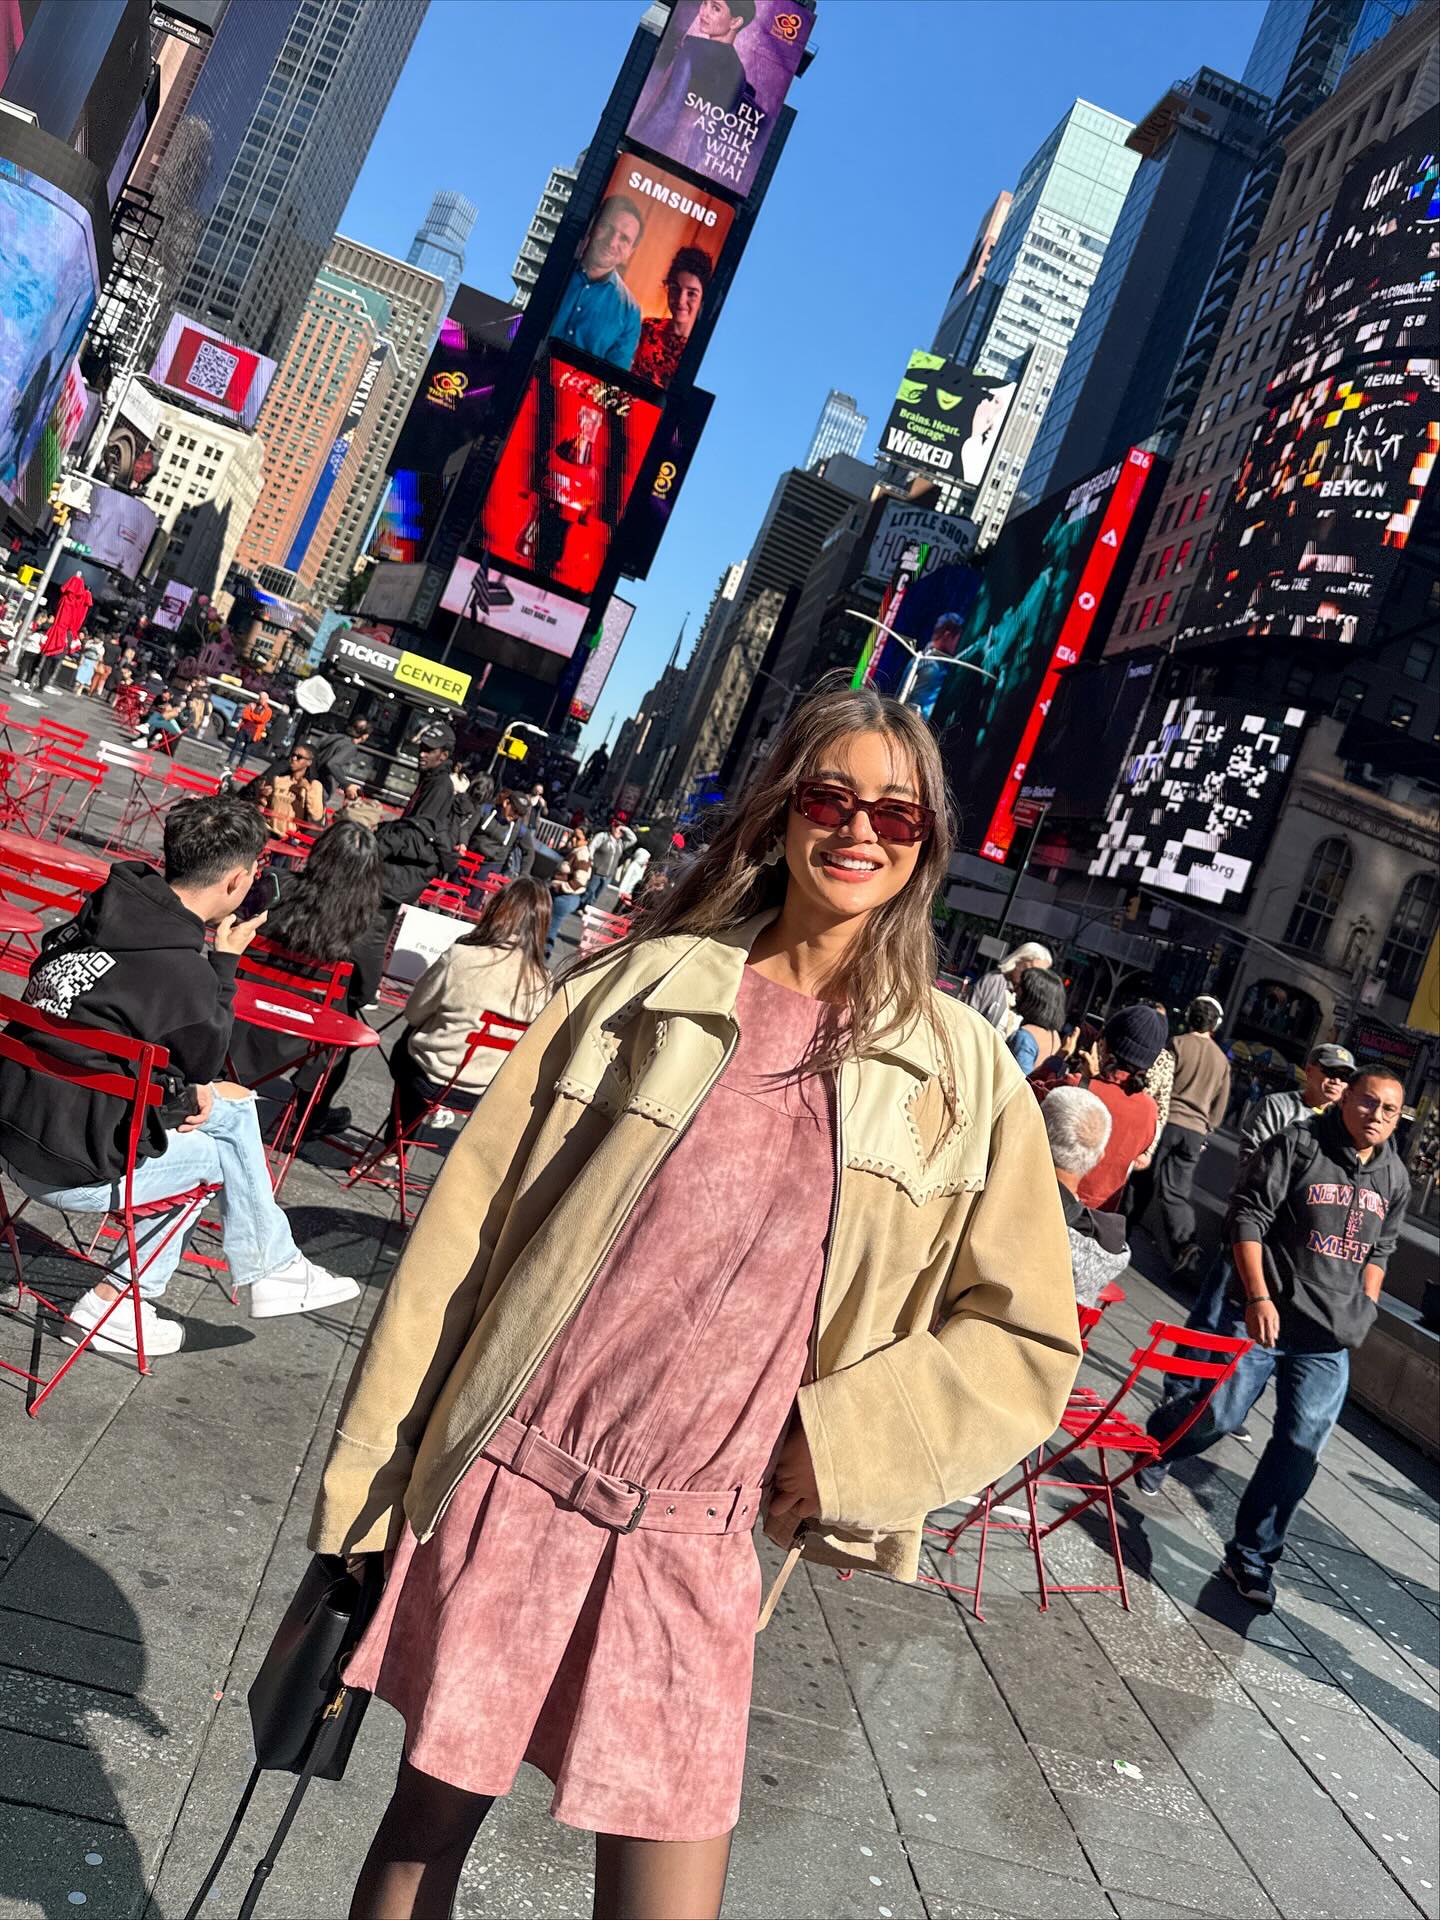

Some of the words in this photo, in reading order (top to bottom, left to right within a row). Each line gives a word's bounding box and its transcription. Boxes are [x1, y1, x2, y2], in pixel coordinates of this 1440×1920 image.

[684, 92, 759, 140] SMOOTH
[738, 103, 765, 125] FLY
[693, 115, 717, 134] AS
[718, 127, 752, 154] SILK
[704, 152, 742, 182] THAI
[707, 136, 747, 168] WITH
[629, 171, 718, 228] SAMSUNG
[899, 408, 931, 426] Brains.
[932, 420, 961, 437] Heart.
[906, 421, 946, 442] Courage.
[890, 511, 940, 530] LITTLE
[939, 518, 970, 548] SHOP
[415, 569, 445, 627] HELLO!
[340, 638, 400, 672] TICKET
[400, 664, 463, 696] CENTER
[1306, 1183, 1354, 1206] NEW
